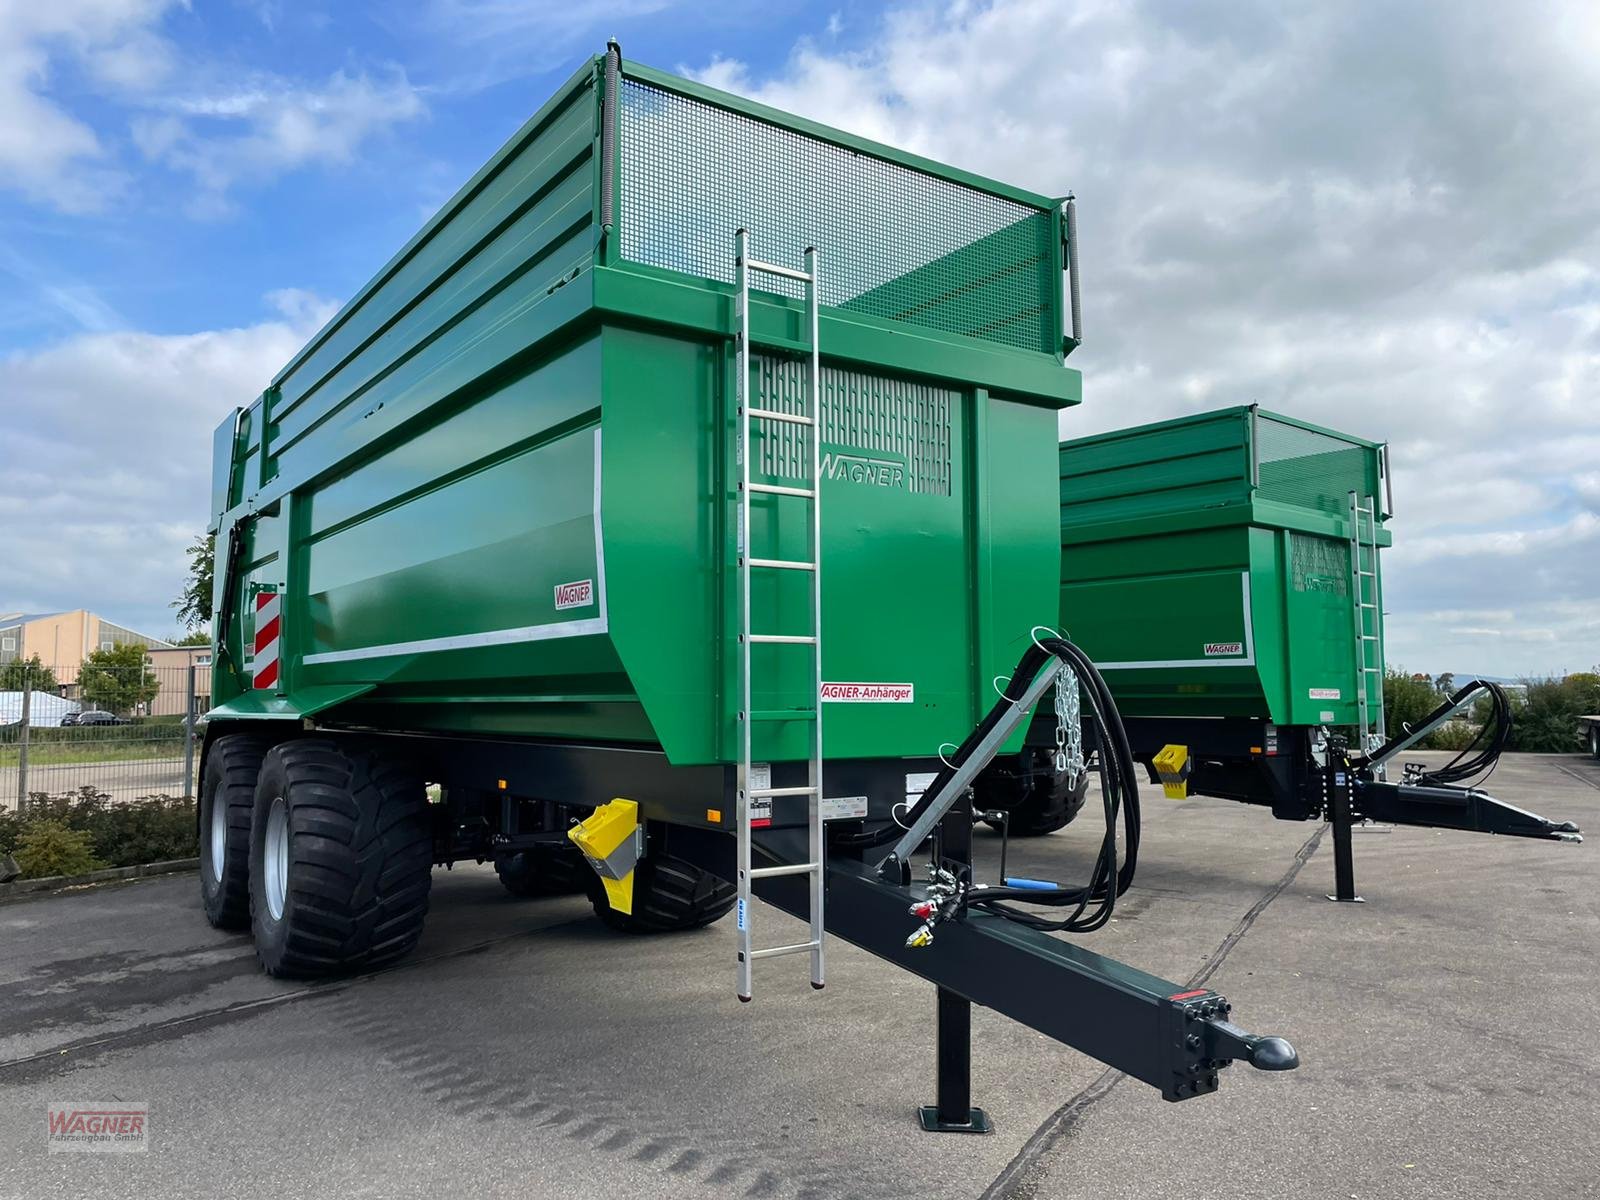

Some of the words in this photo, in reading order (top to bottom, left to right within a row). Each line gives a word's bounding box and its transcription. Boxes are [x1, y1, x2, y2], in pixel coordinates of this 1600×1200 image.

[555, 581, 591, 605] WAGNER
[1205, 643, 1241, 654] WAGNER
[820, 683, 912, 701] AGNER-Anhänger
